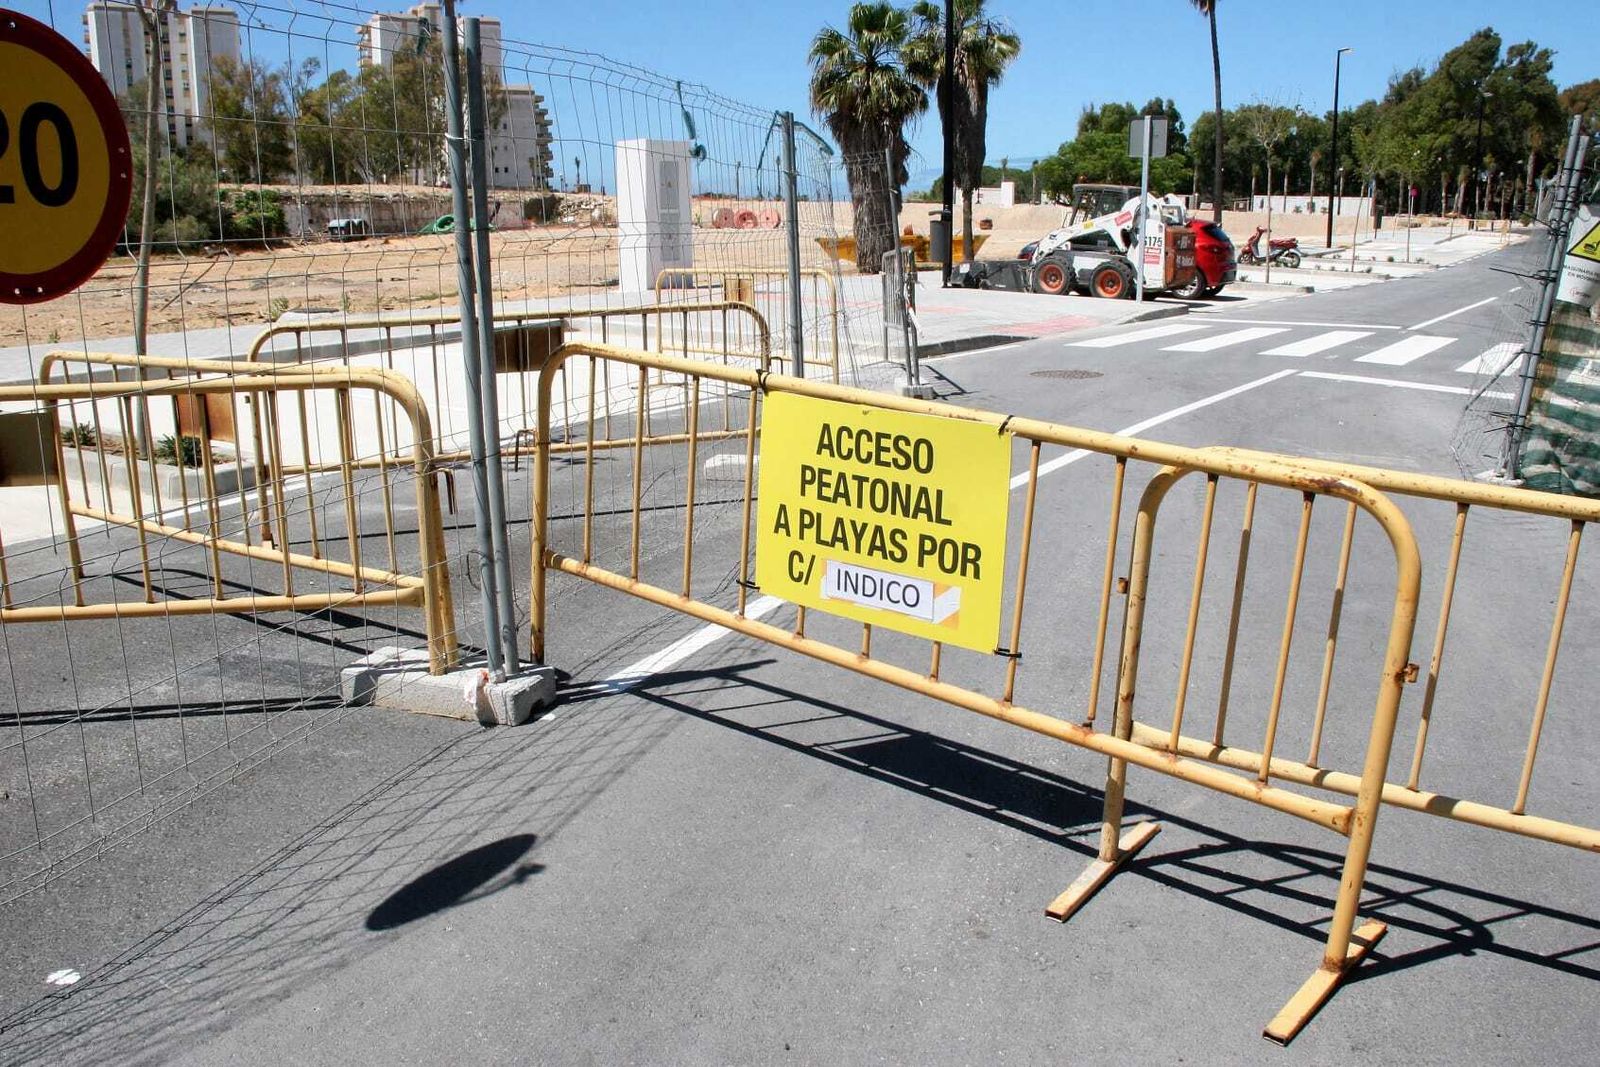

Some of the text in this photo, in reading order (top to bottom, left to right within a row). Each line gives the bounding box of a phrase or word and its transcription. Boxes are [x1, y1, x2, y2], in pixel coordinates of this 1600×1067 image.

[816, 423, 934, 474] ACCESO
[800, 464, 953, 526] PEATONAL
[773, 503, 982, 580] A PLAYAS POR
[787, 550, 921, 608] C/ INDICO
